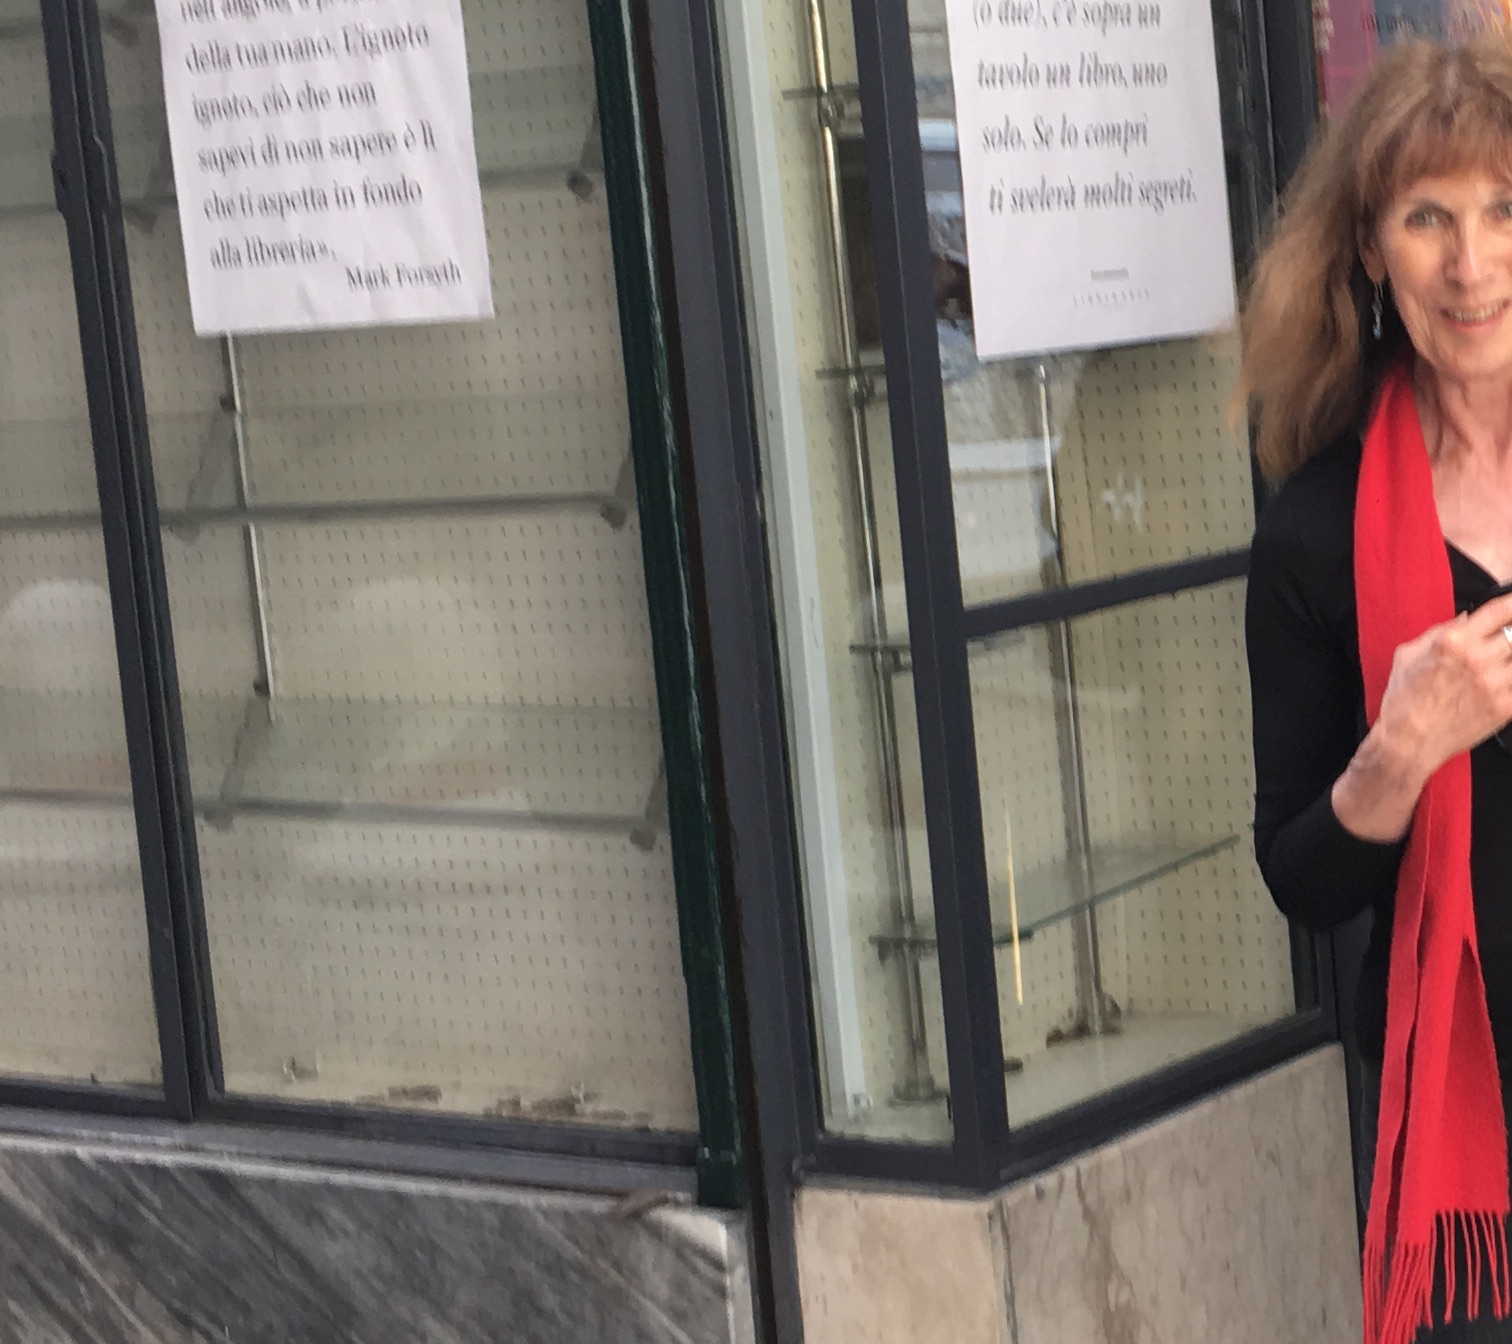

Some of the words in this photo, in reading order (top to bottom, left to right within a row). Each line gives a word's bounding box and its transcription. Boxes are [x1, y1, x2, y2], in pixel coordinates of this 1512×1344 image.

[1137, 2, 1162, 30] un
[185, 39, 232, 76] della
[236, 40, 269, 70] tua
[977, 50, 1041, 91] tavolo
[1046, 61, 1072, 89] un
[1131, 61, 1168, 89] uno
[192, 92, 259, 130] ignoto,
[262, 82, 292, 116] ciò
[296, 79, 331, 114] che
[337, 81, 377, 110] non
[1032, 113, 1055, 152] Se
[1060, 112, 1079, 151] lo
[1084, 111, 1149, 158] compri
[203, 189, 237, 222] che
[239, 186, 254, 219] ti
[257, 184, 329, 222] aspetta
[333, 178, 357, 212] in
[363, 172, 423, 208] fondo
[988, 177, 1004, 215] ti
[1010, 173, 1076, 215] svelerà
[1083, 170, 1134, 209] molti
[210, 237, 243, 271] alla
